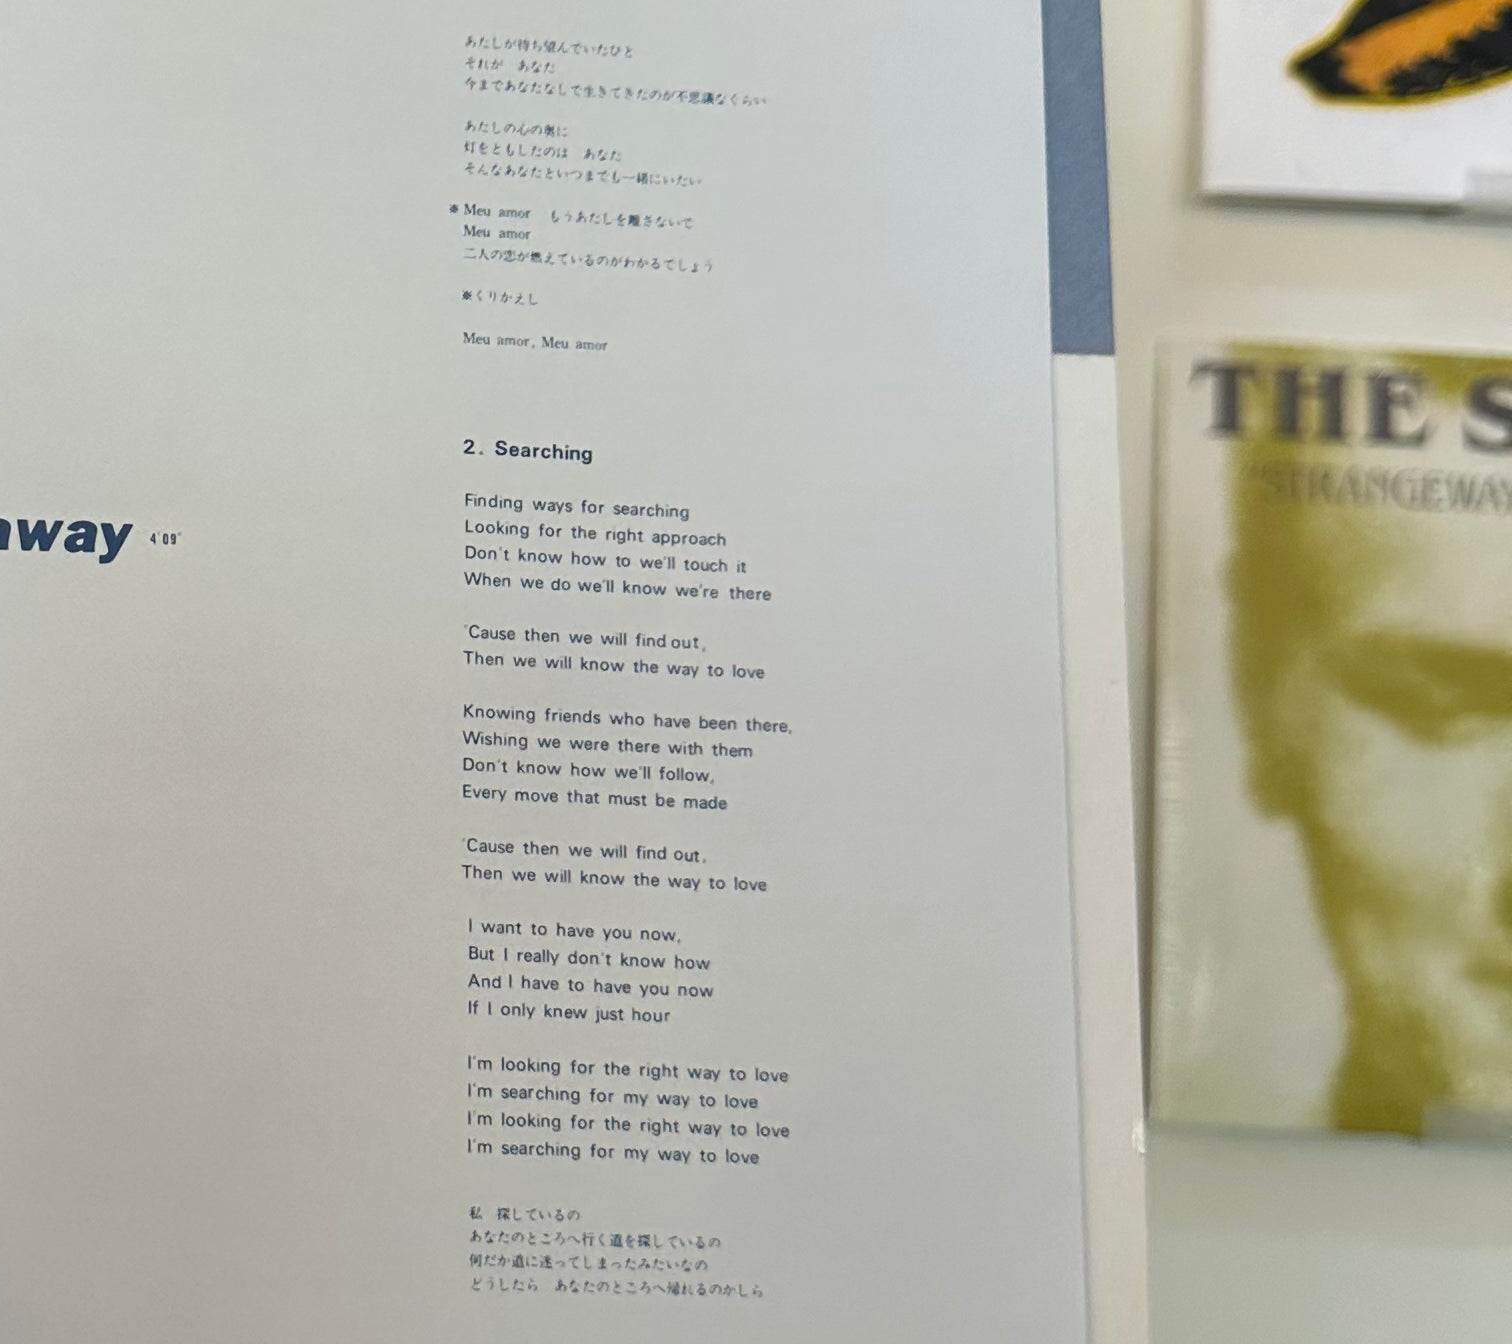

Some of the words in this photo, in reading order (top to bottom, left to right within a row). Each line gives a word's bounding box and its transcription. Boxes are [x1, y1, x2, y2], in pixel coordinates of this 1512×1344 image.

[463, 332, 490, 345] Meu
[541, 336, 569, 349] Meu
[575, 340, 608, 351] amor
[1190, 359, 1431, 448] THE
[494, 440, 593, 465] Searching
[465, 491, 524, 514] Finding
[532, 500, 574, 517] ways
[581, 499, 605, 515] for
[611, 503, 690, 522] searching
[465, 518, 532, 540] Looking
[538, 522, 563, 541] for
[570, 525, 599, 540] the
[605, 525, 645, 545] right
[651, 530, 726, 547] approach
[463, 703, 536, 724] Knowing
[544, 707, 602, 726] friends
[609, 712, 645, 728] who
[653, 713, 692, 730] have
[698, 714, 738, 731] been
[501, 1056, 561, 1079] looking
[569, 1059, 598, 1078] for
[603, 1060, 632, 1079] the
[639, 1062, 680, 1082] right
[686, 1068, 721, 1083] way
[728, 1068, 747, 1082] to
[755, 1067, 790, 1084] love
